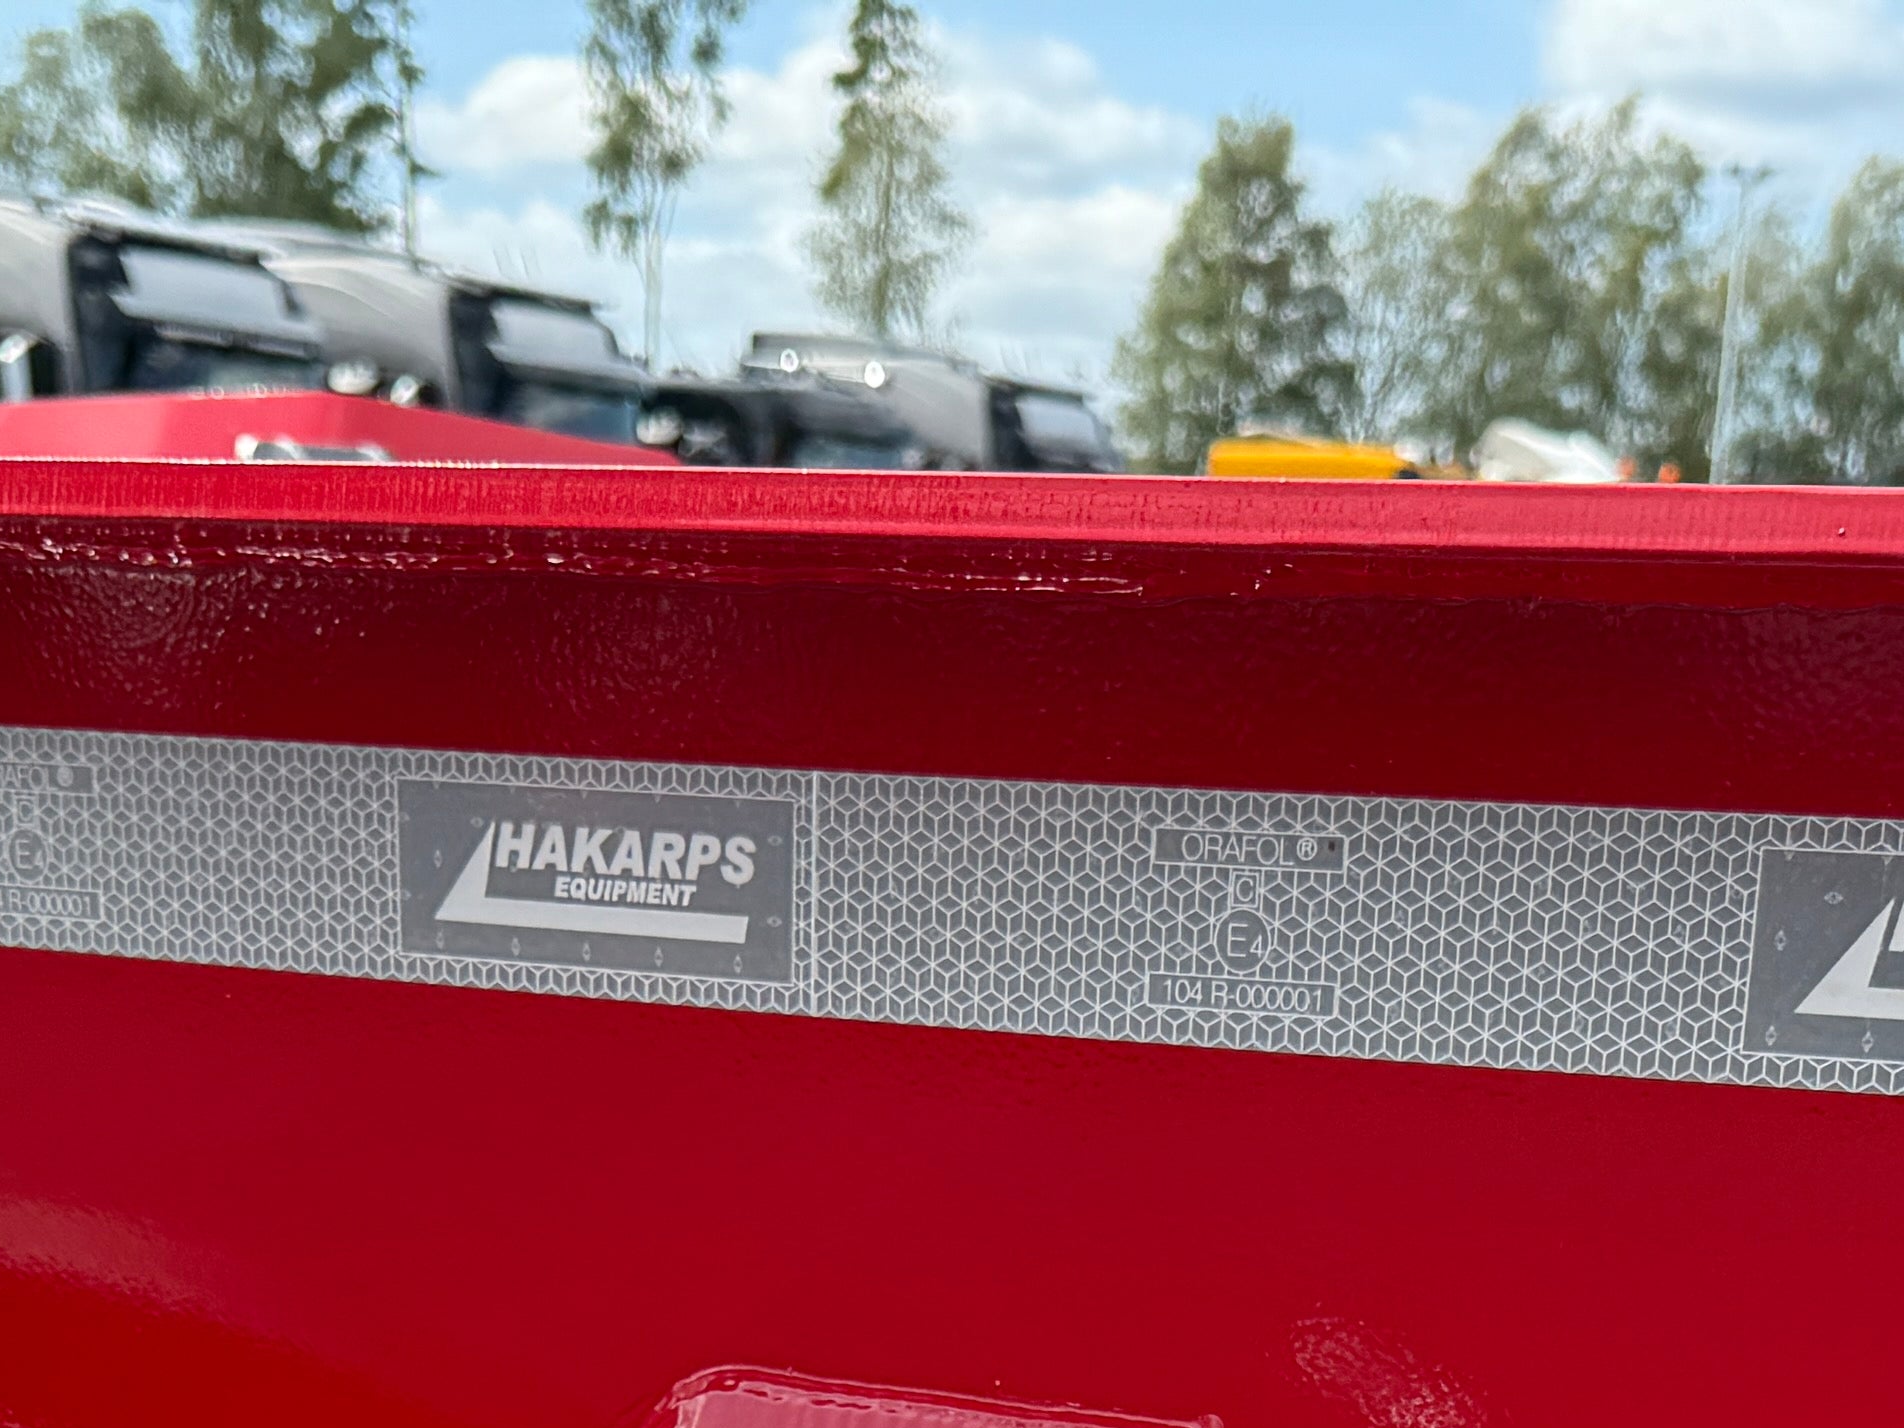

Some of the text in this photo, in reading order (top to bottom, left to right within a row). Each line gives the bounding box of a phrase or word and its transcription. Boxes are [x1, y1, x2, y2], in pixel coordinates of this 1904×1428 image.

[496, 821, 757, 886] HAKARPS
[554, 876, 697, 907] EQUIPMENT
[1162, 978, 1323, 1013] 104 R-000001
